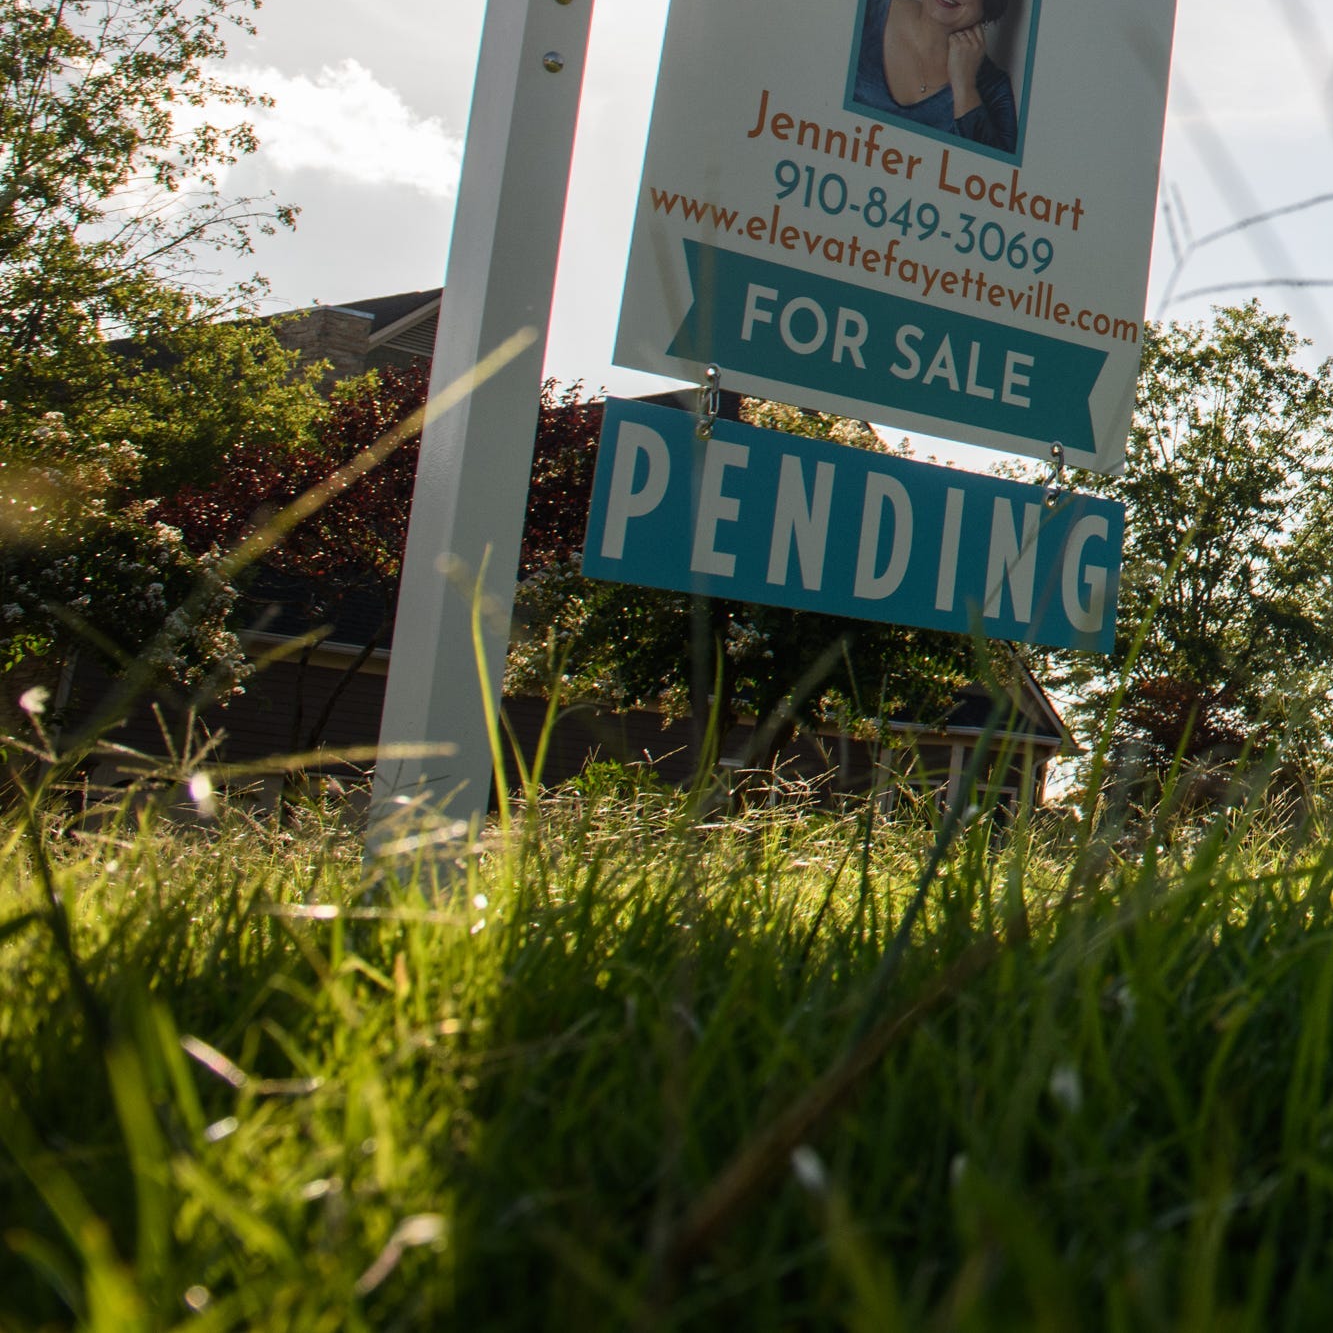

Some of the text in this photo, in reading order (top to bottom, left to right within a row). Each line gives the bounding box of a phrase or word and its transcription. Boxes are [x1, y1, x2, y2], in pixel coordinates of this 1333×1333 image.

[747, 90, 1085, 231] Jennifer Lockart
[774, 159, 1055, 275] 910-849-3069
[650, 186, 1138, 344] www.elevatefayetteville.com
[740, 282, 1036, 408] FOR SALE
[600, 420, 1109, 633] PENDING
